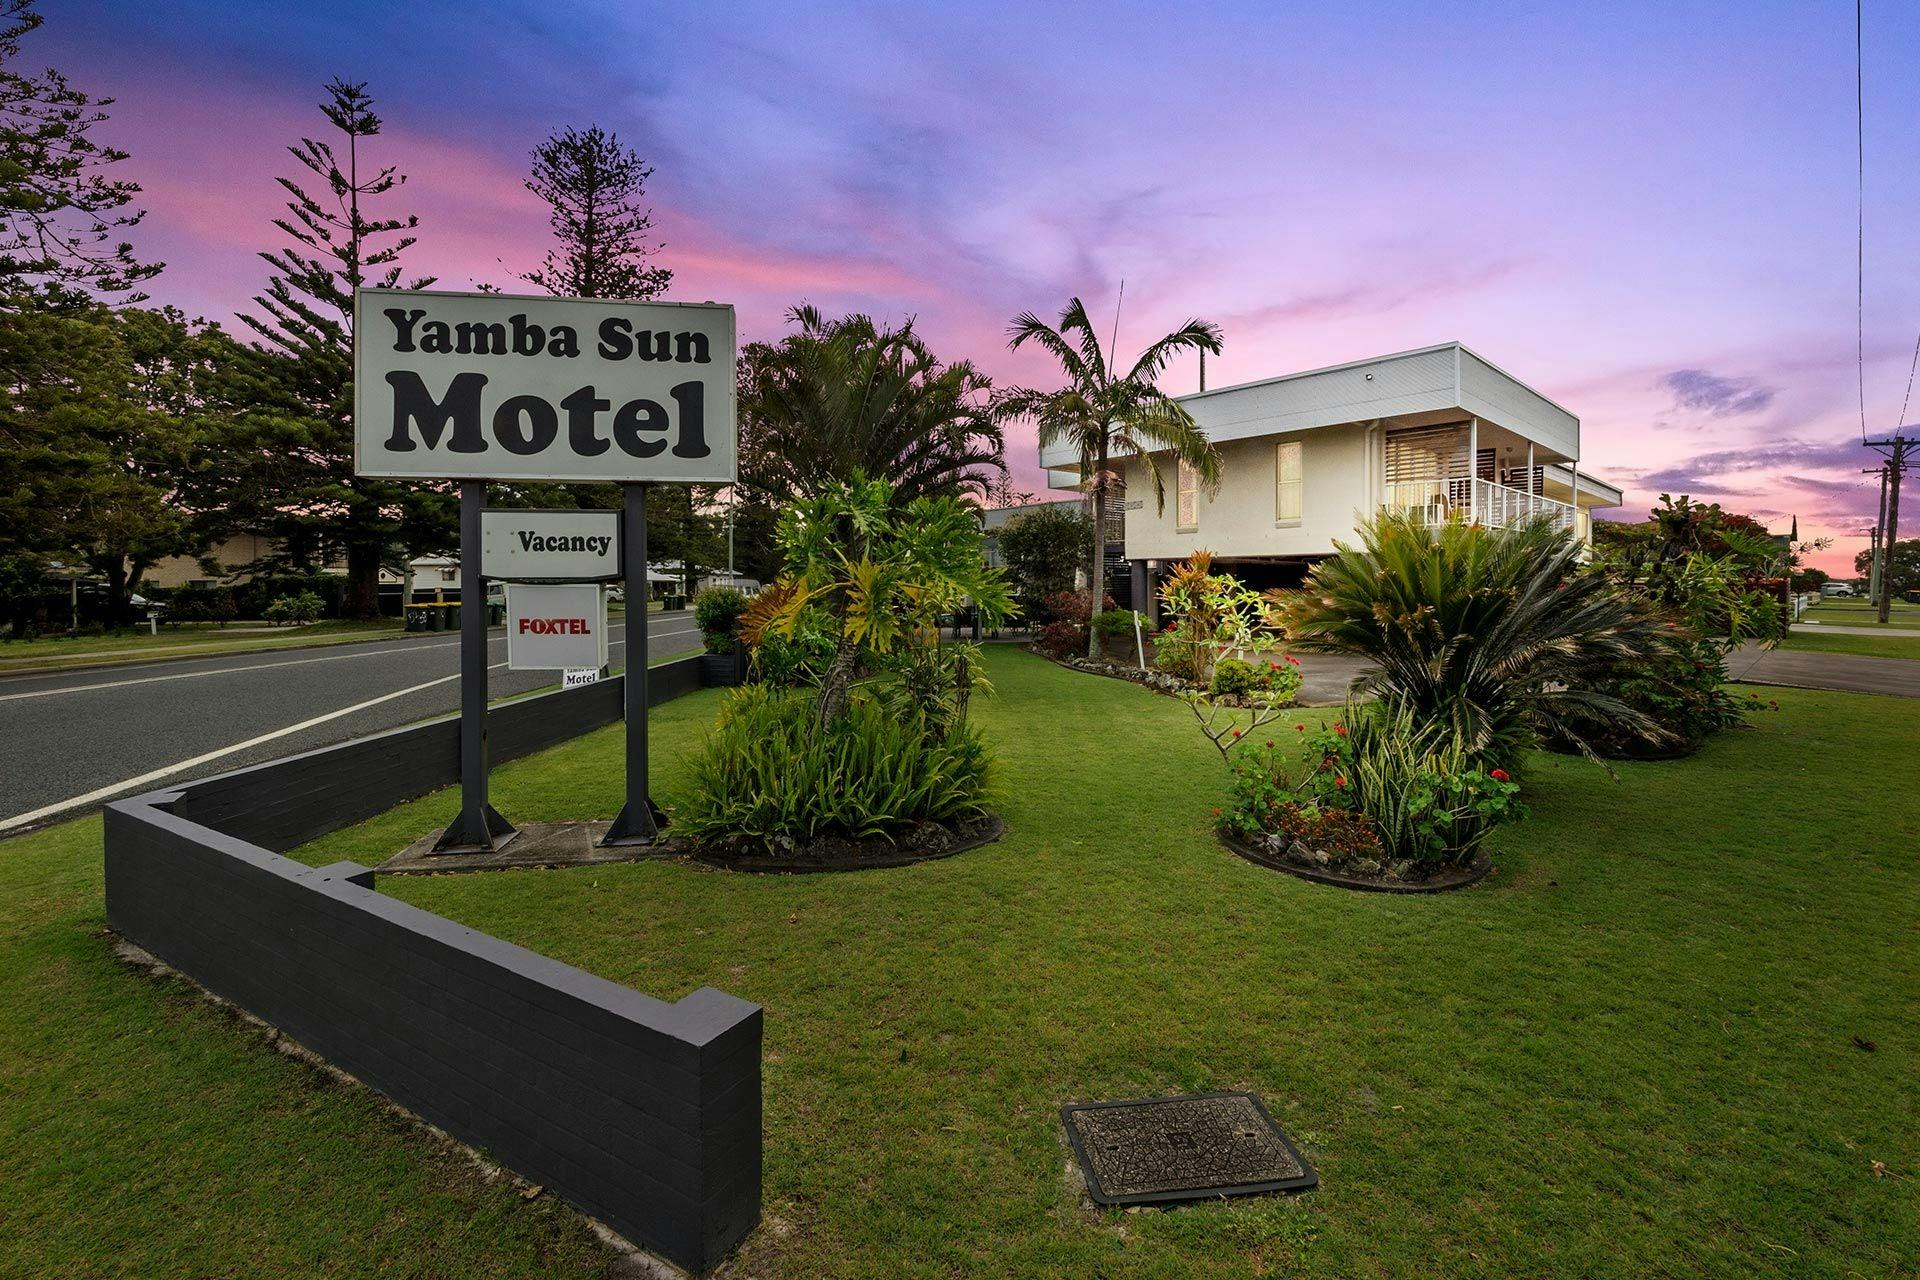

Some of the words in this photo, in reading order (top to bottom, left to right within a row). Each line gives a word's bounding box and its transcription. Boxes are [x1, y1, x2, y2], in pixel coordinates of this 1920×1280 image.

[383, 308, 581, 359] Yamba
[597, 317, 712, 364] Sun
[384, 370, 712, 459] Motel
[518, 530, 612, 557] Vacancy
[519, 618, 591, 635] FOXTEL
[566, 673, 596, 685] Motel
